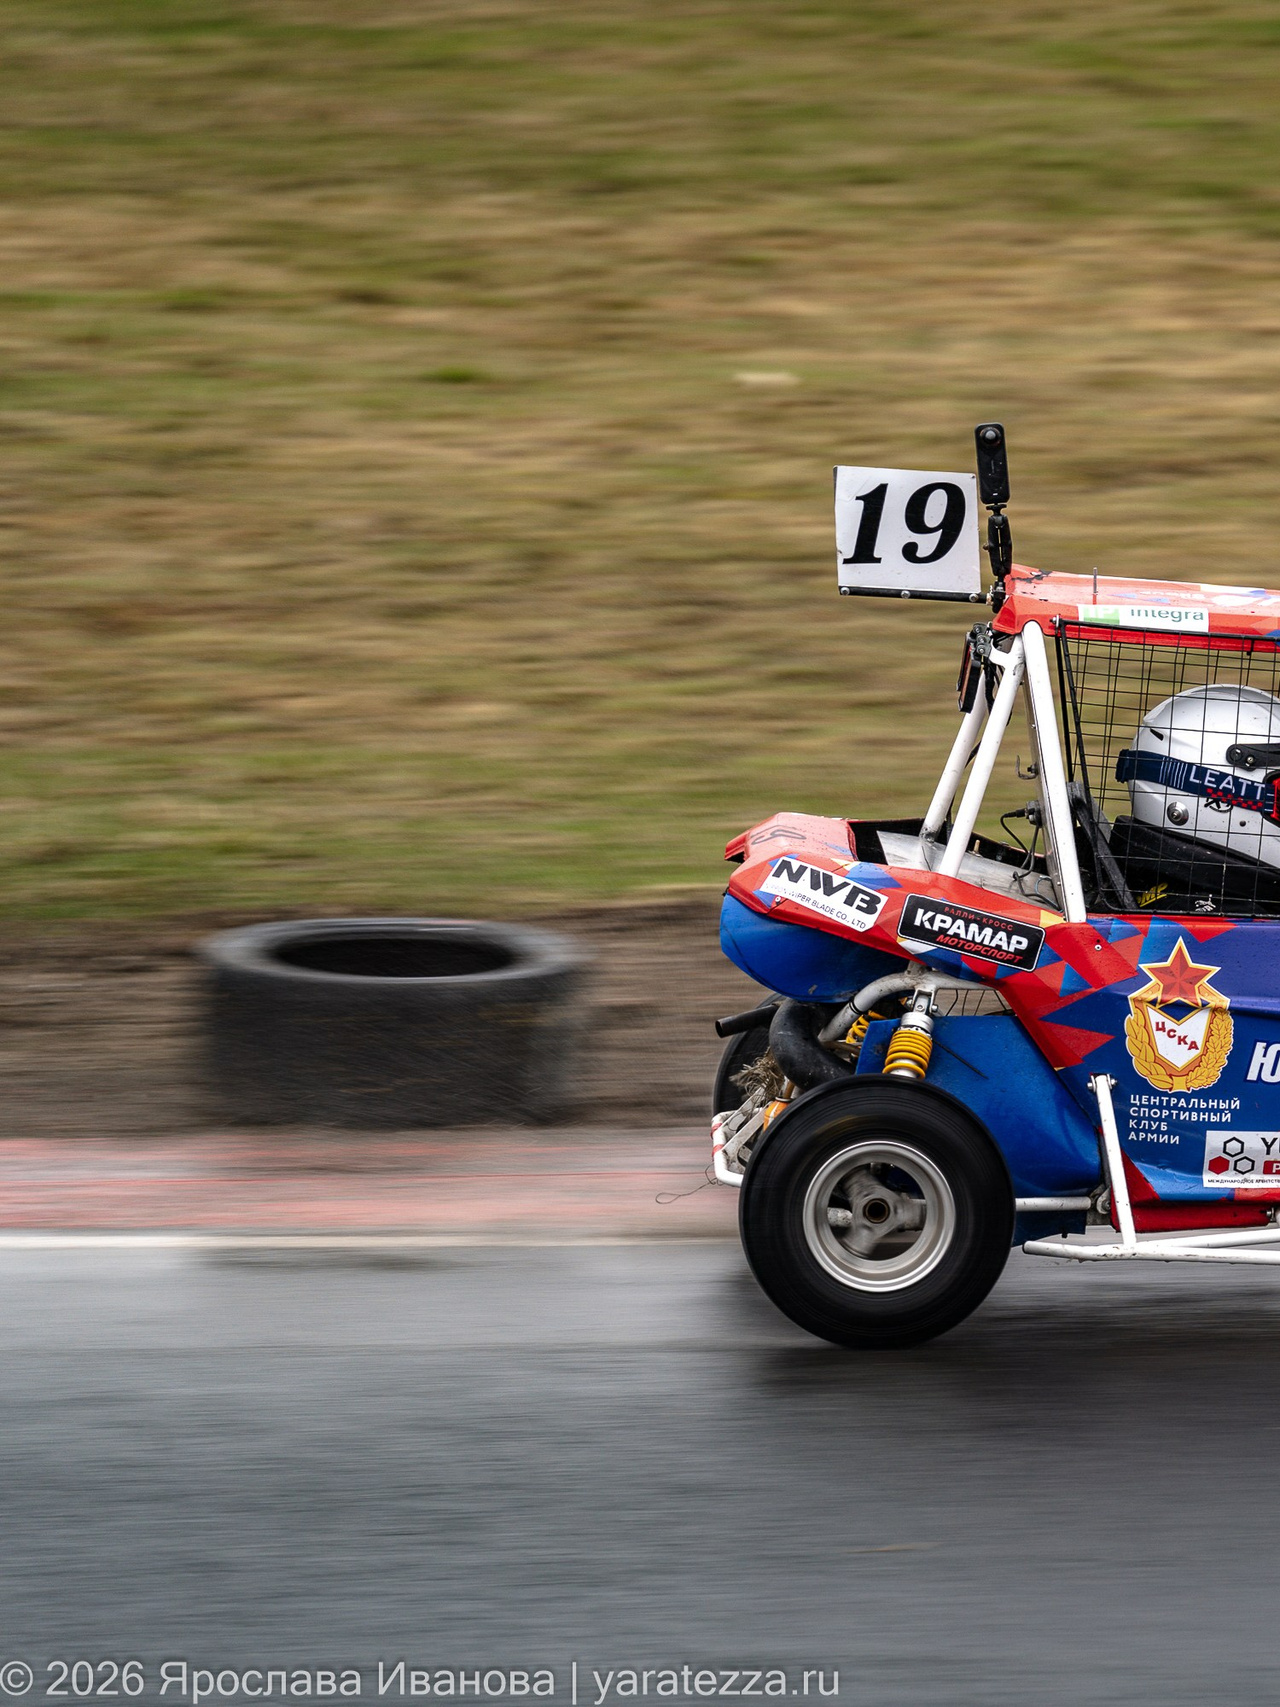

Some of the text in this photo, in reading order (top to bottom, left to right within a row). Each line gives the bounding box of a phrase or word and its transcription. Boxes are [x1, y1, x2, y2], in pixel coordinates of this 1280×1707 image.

[842, 481, 966, 565] 19
[1189, 765, 1265, 800] LEATT
[772, 859, 882, 915] NWB
[811, 899, 834, 915] BLADE
[851, 918, 867, 930] LTD
[913, 908, 1028, 953] КРАМАР
[936, 934, 1023, 963] МОТОРСПОРТ
[1155, 1021, 1199, 1050] ЦСКА
[1129, 1107, 1231, 1123] СПОРТИВНЫЙ
[1130, 1094, 1240, 1110] ЦЕНТРАЛЬНЫЙ
[1128, 1131, 1180, 1145] АРМИИ
[1129, 1119, 1168, 1131] КЛУБ
